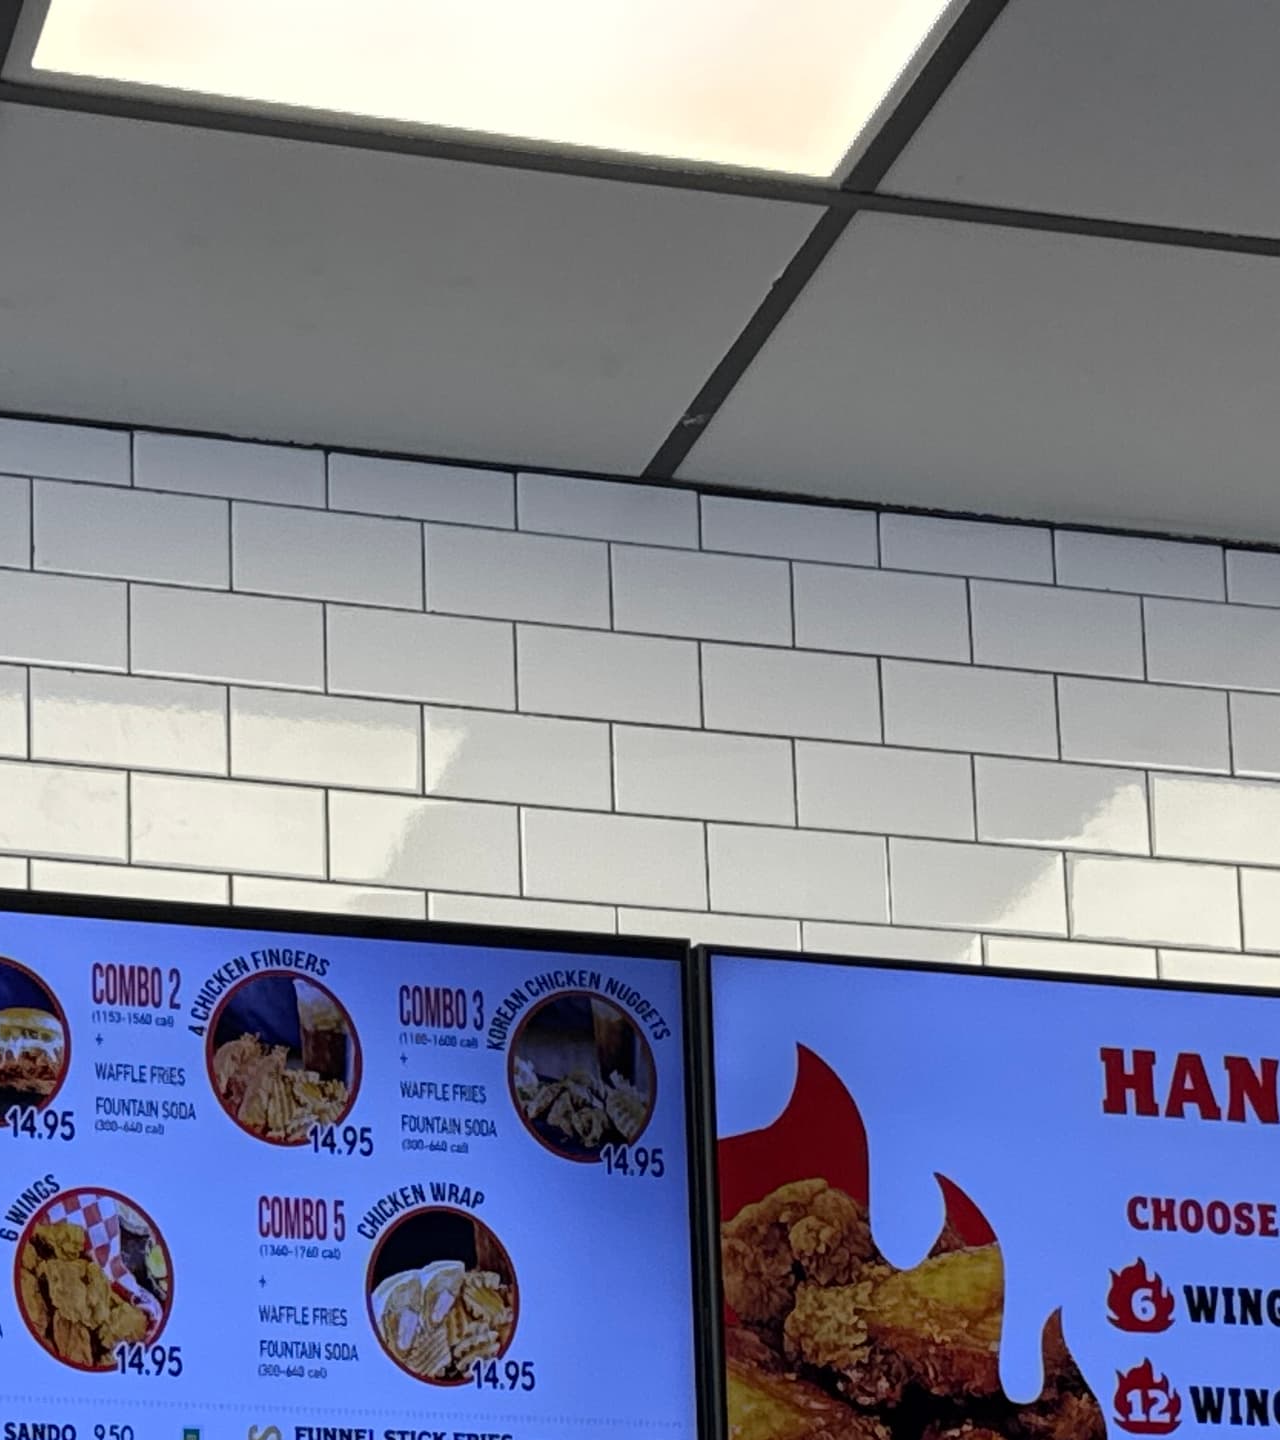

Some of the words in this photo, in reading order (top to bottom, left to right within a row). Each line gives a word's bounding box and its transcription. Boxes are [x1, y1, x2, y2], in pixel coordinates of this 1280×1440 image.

[93, 963, 162, 1008] COMBO
[169, 969, 180, 1009] 2
[400, 985, 467, 1029] COMBO
[473, 990, 484, 1031] 3
[7, 1108, 76, 1141] 14.95
[309, 1126, 374, 1157] 14.95
[1127, 1196, 1279, 1237] CHOOSE
[1132, 1289, 1156, 1322] 6
[1126, 1388, 1171, 1423] 12
